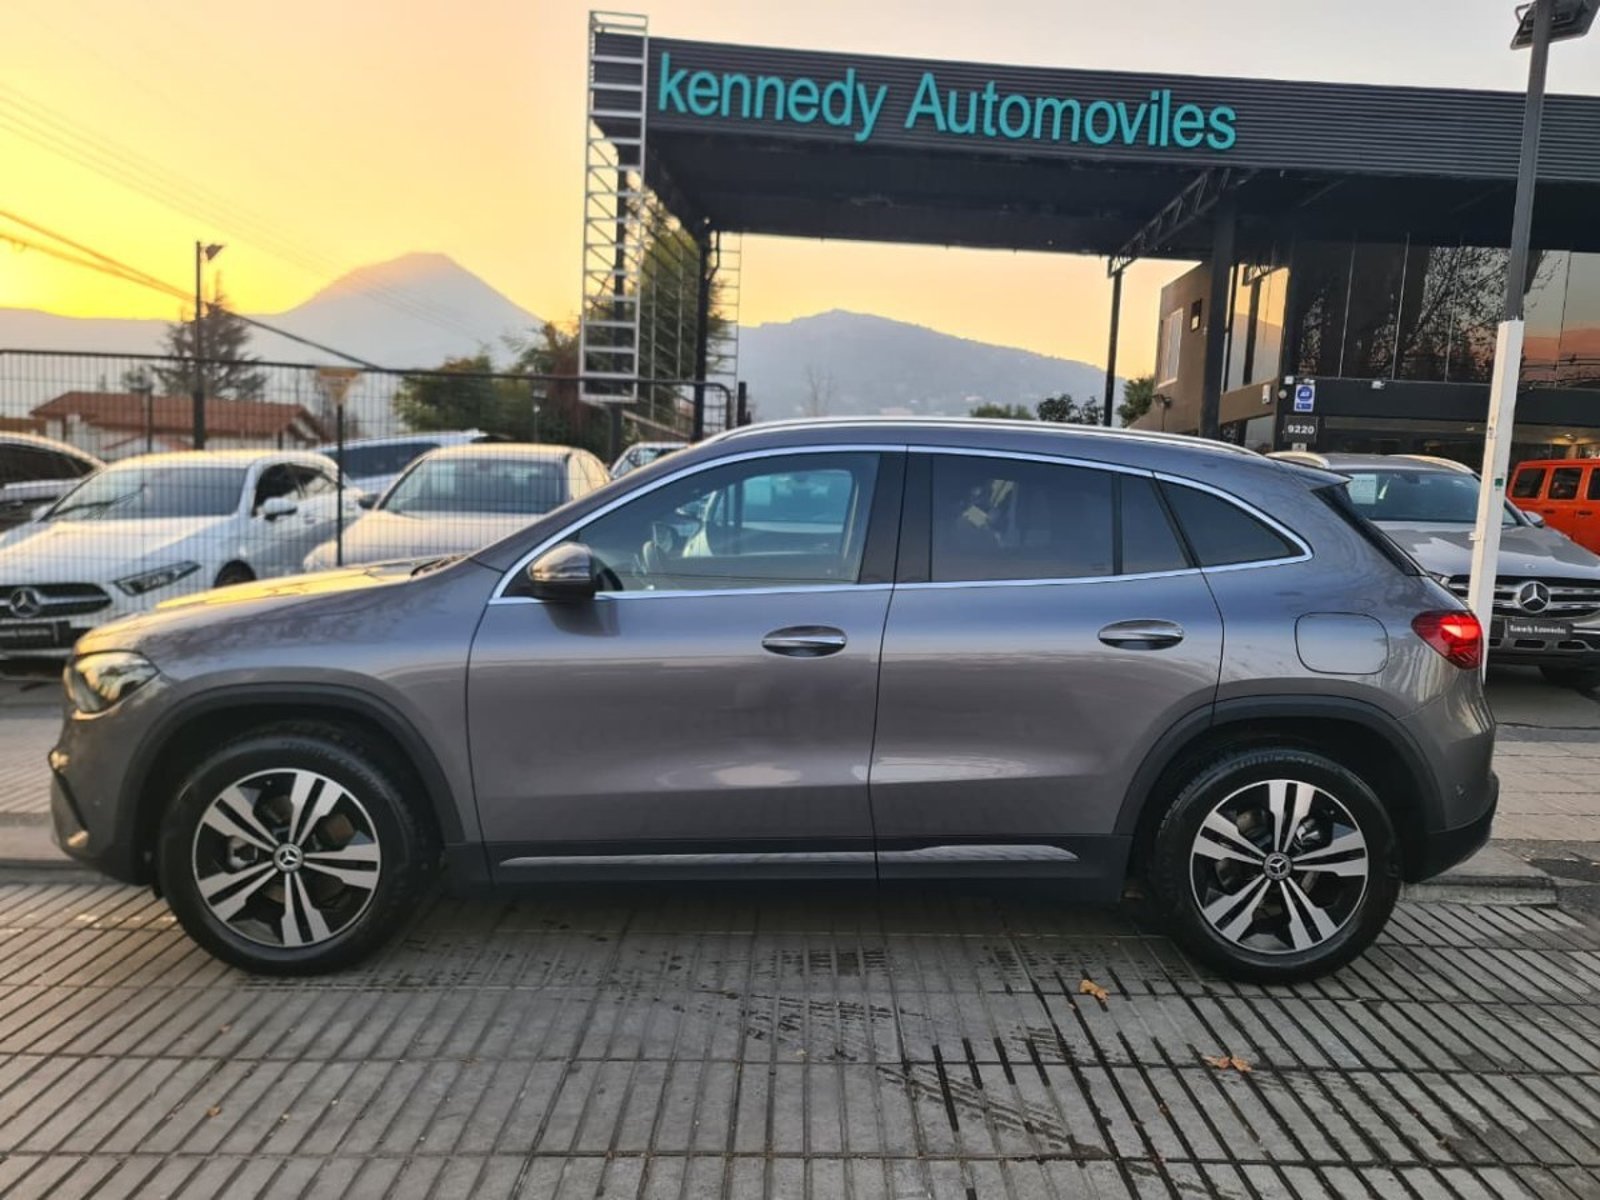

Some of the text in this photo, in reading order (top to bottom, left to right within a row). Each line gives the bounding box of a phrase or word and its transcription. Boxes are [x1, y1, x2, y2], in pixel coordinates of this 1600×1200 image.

[658, 52, 1236, 149] kennedy Automoviles
[1287, 424, 1315, 435] 9220
